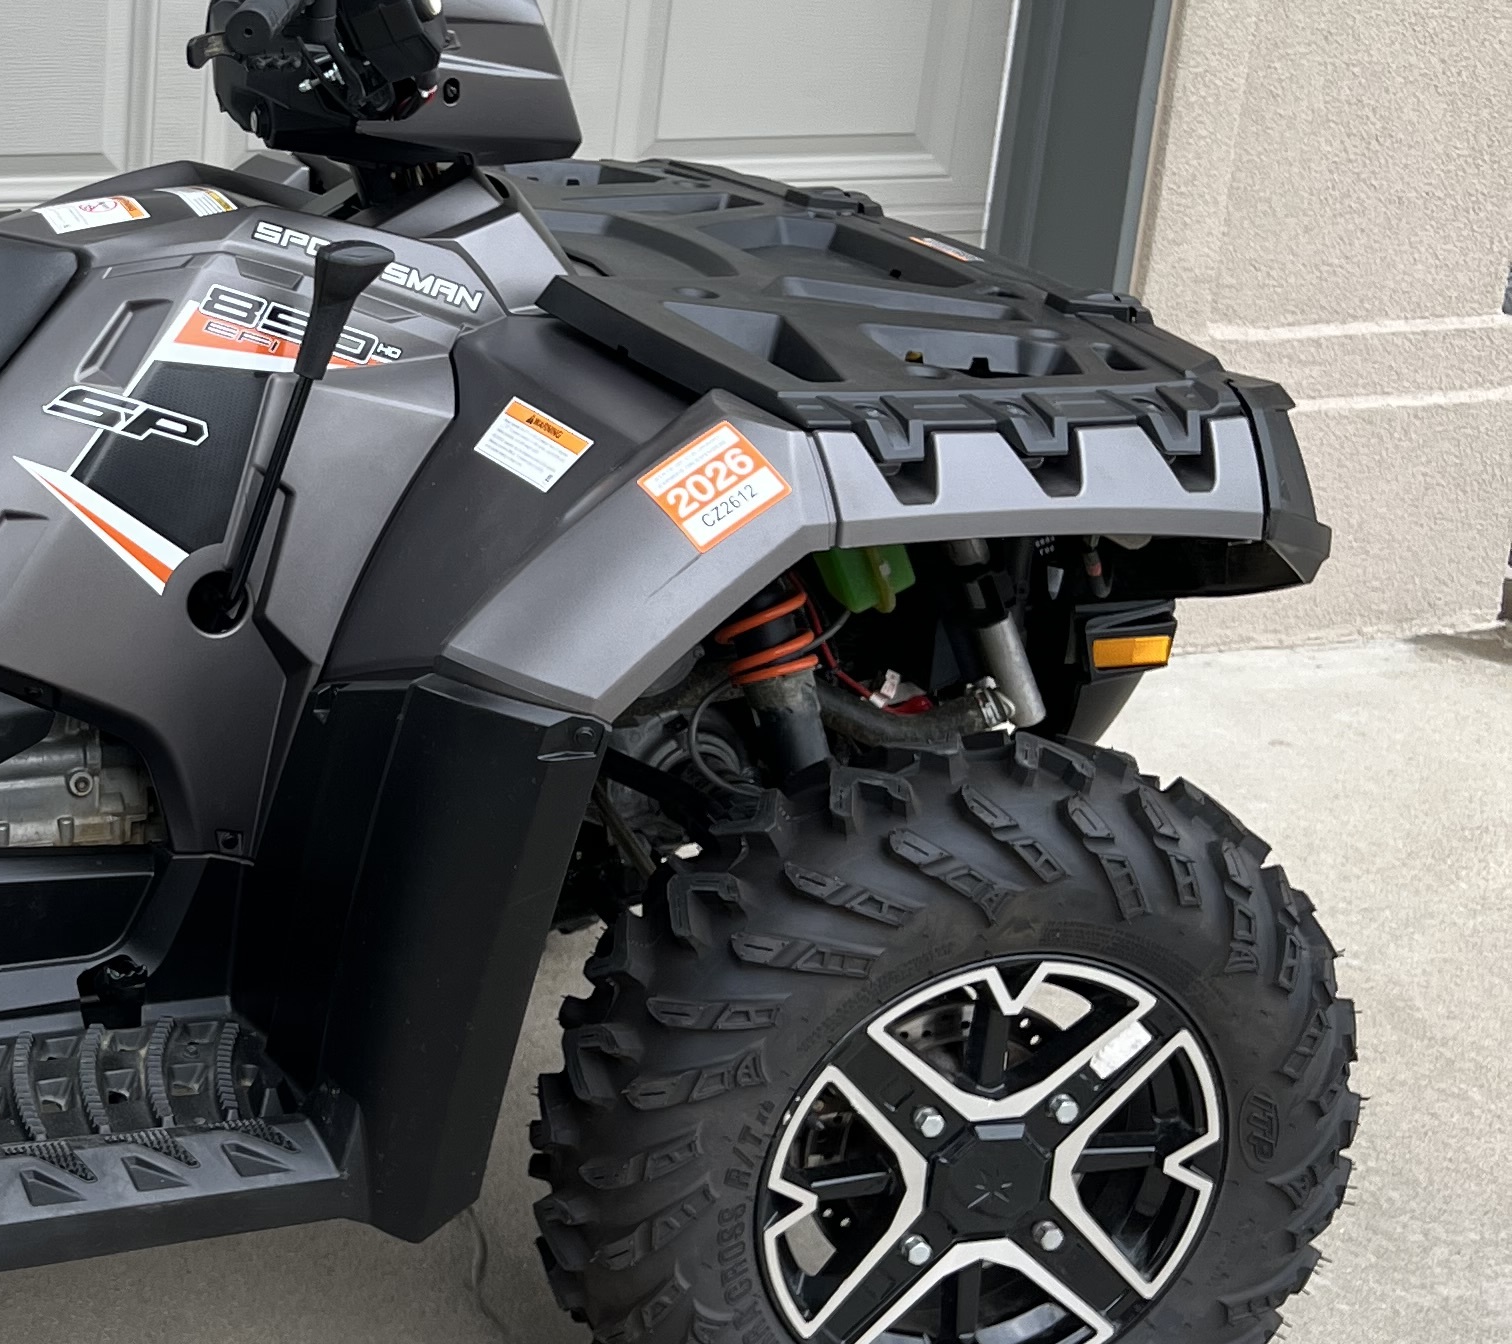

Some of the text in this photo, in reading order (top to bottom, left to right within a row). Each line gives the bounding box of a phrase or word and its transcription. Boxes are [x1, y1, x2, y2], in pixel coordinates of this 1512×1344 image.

[202, 319, 279, 354] EFI
[42, 385, 210, 447] SP
[666, 447, 755, 519] 2026
[701, 484, 758, 527] CZ2612
[724, 1123, 763, 1191] R/T
[1247, 1093, 1277, 1164] ITP
[717, 1201, 754, 1306] CROSS
